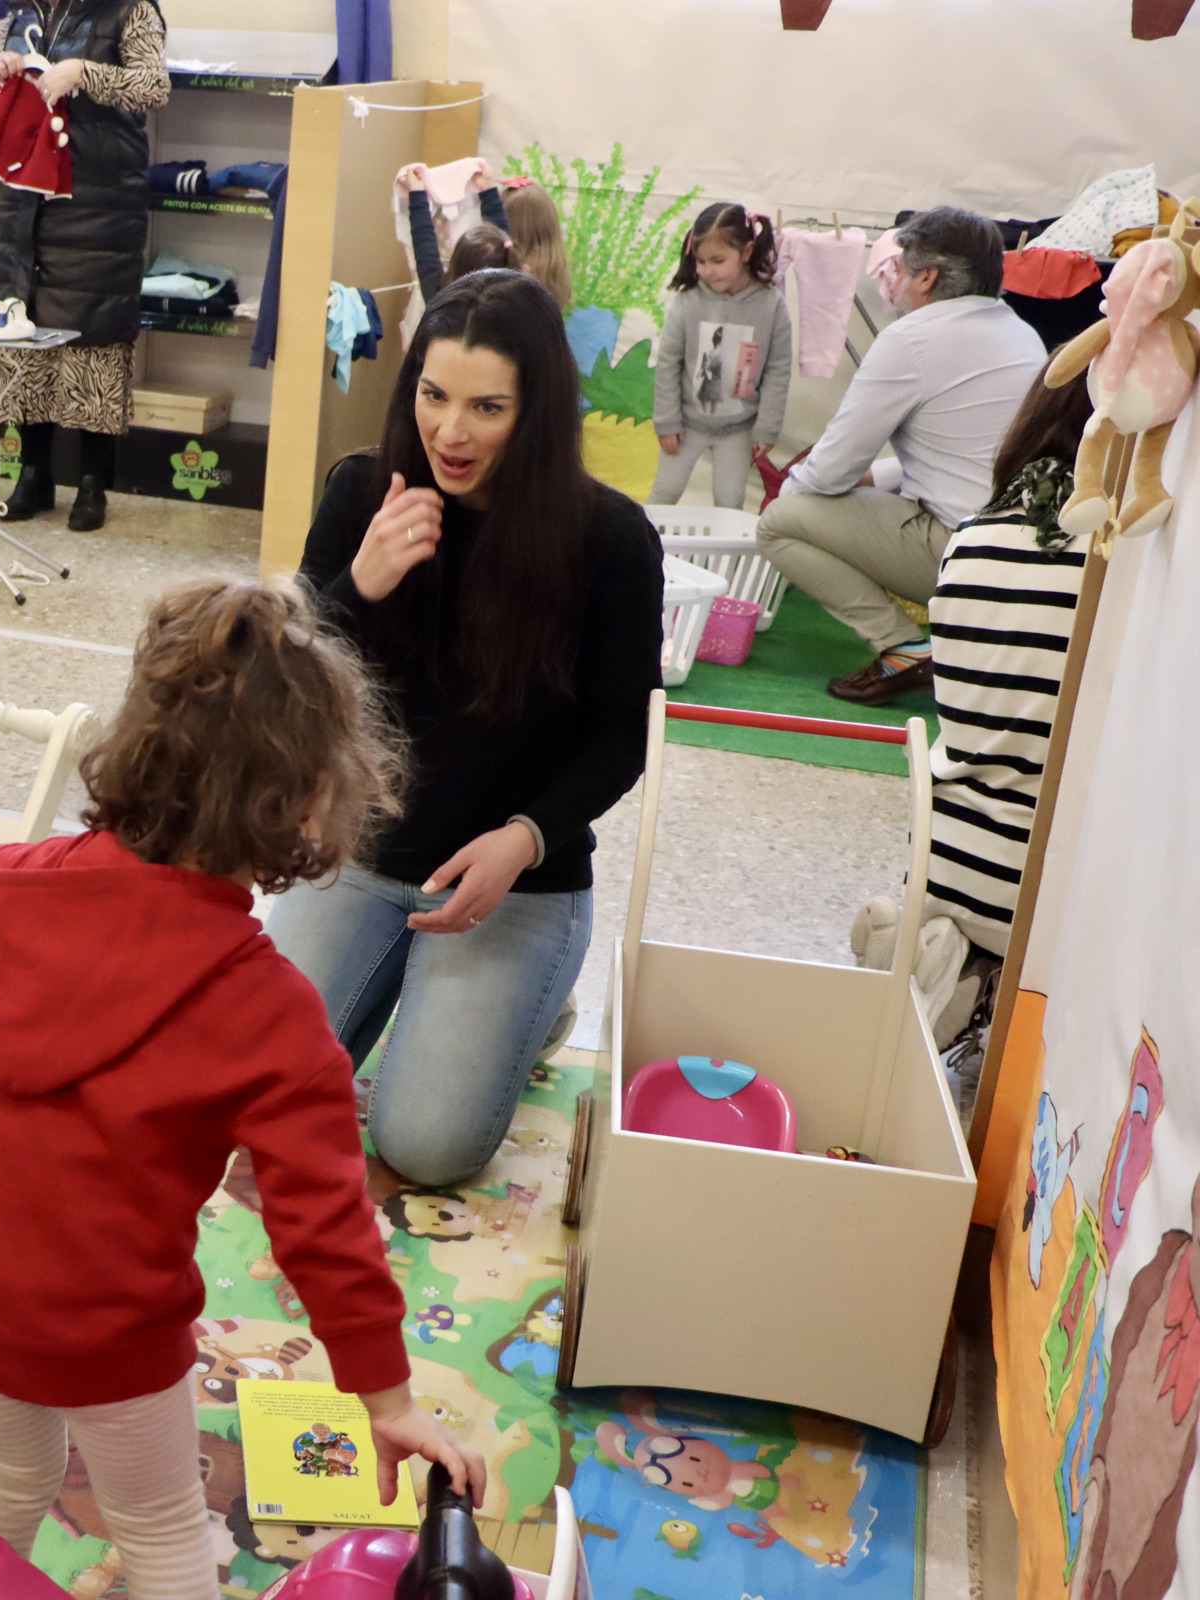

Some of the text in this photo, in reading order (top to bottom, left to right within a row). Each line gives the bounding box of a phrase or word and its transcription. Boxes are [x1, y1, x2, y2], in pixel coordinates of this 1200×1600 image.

[163, 199, 271, 214] FRITOS CON ACEITE DE OLIVA
